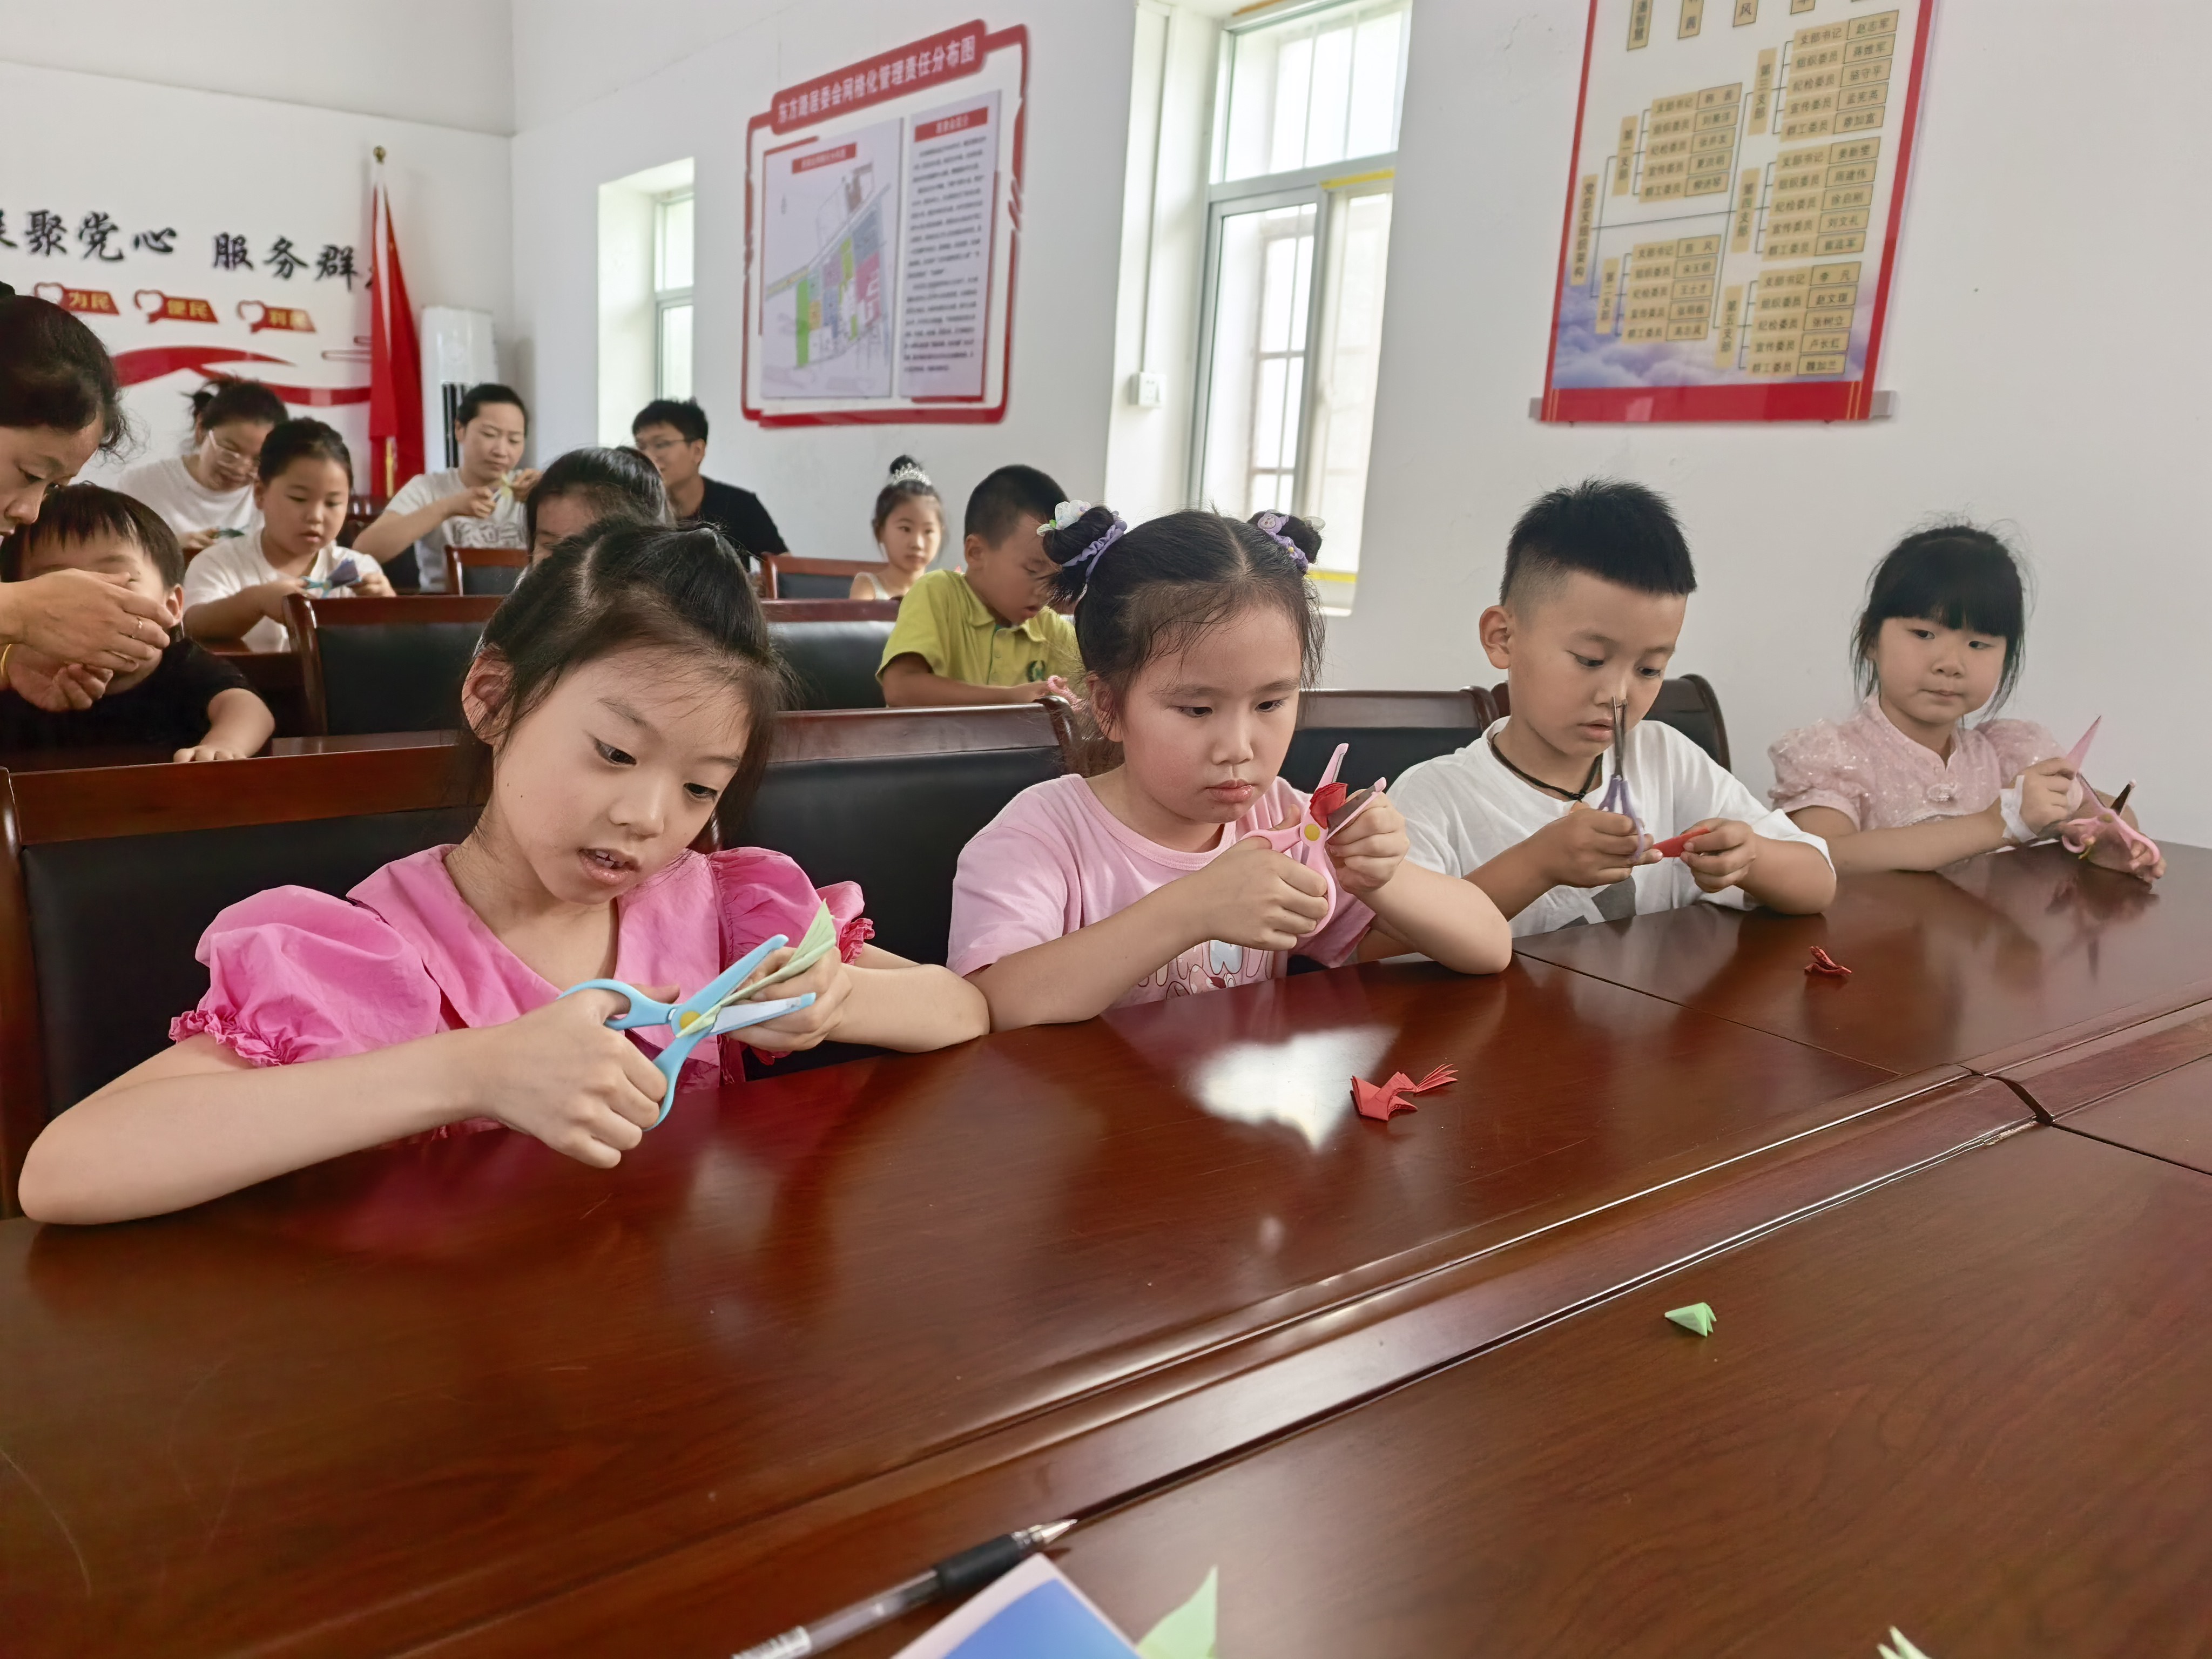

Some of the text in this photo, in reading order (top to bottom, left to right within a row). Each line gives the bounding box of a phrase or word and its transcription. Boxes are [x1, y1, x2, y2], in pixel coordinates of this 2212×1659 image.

[1801, 28, 1842, 44] 支部书记
[1797, 50, 1838, 68] 组织委员
[1793, 73, 1835, 92] 纪检委员
[1790, 97, 1832, 114] 宣传委员
[1783, 151, 1824, 168] 支部书记
[1772, 219, 1813, 234] 宣传委员
[211, 232, 376, 292] 服务群
[1765, 273, 1805, 286] 支部书记
[68, 292, 112, 311] 为民
[167, 298, 210, 319] 便民
